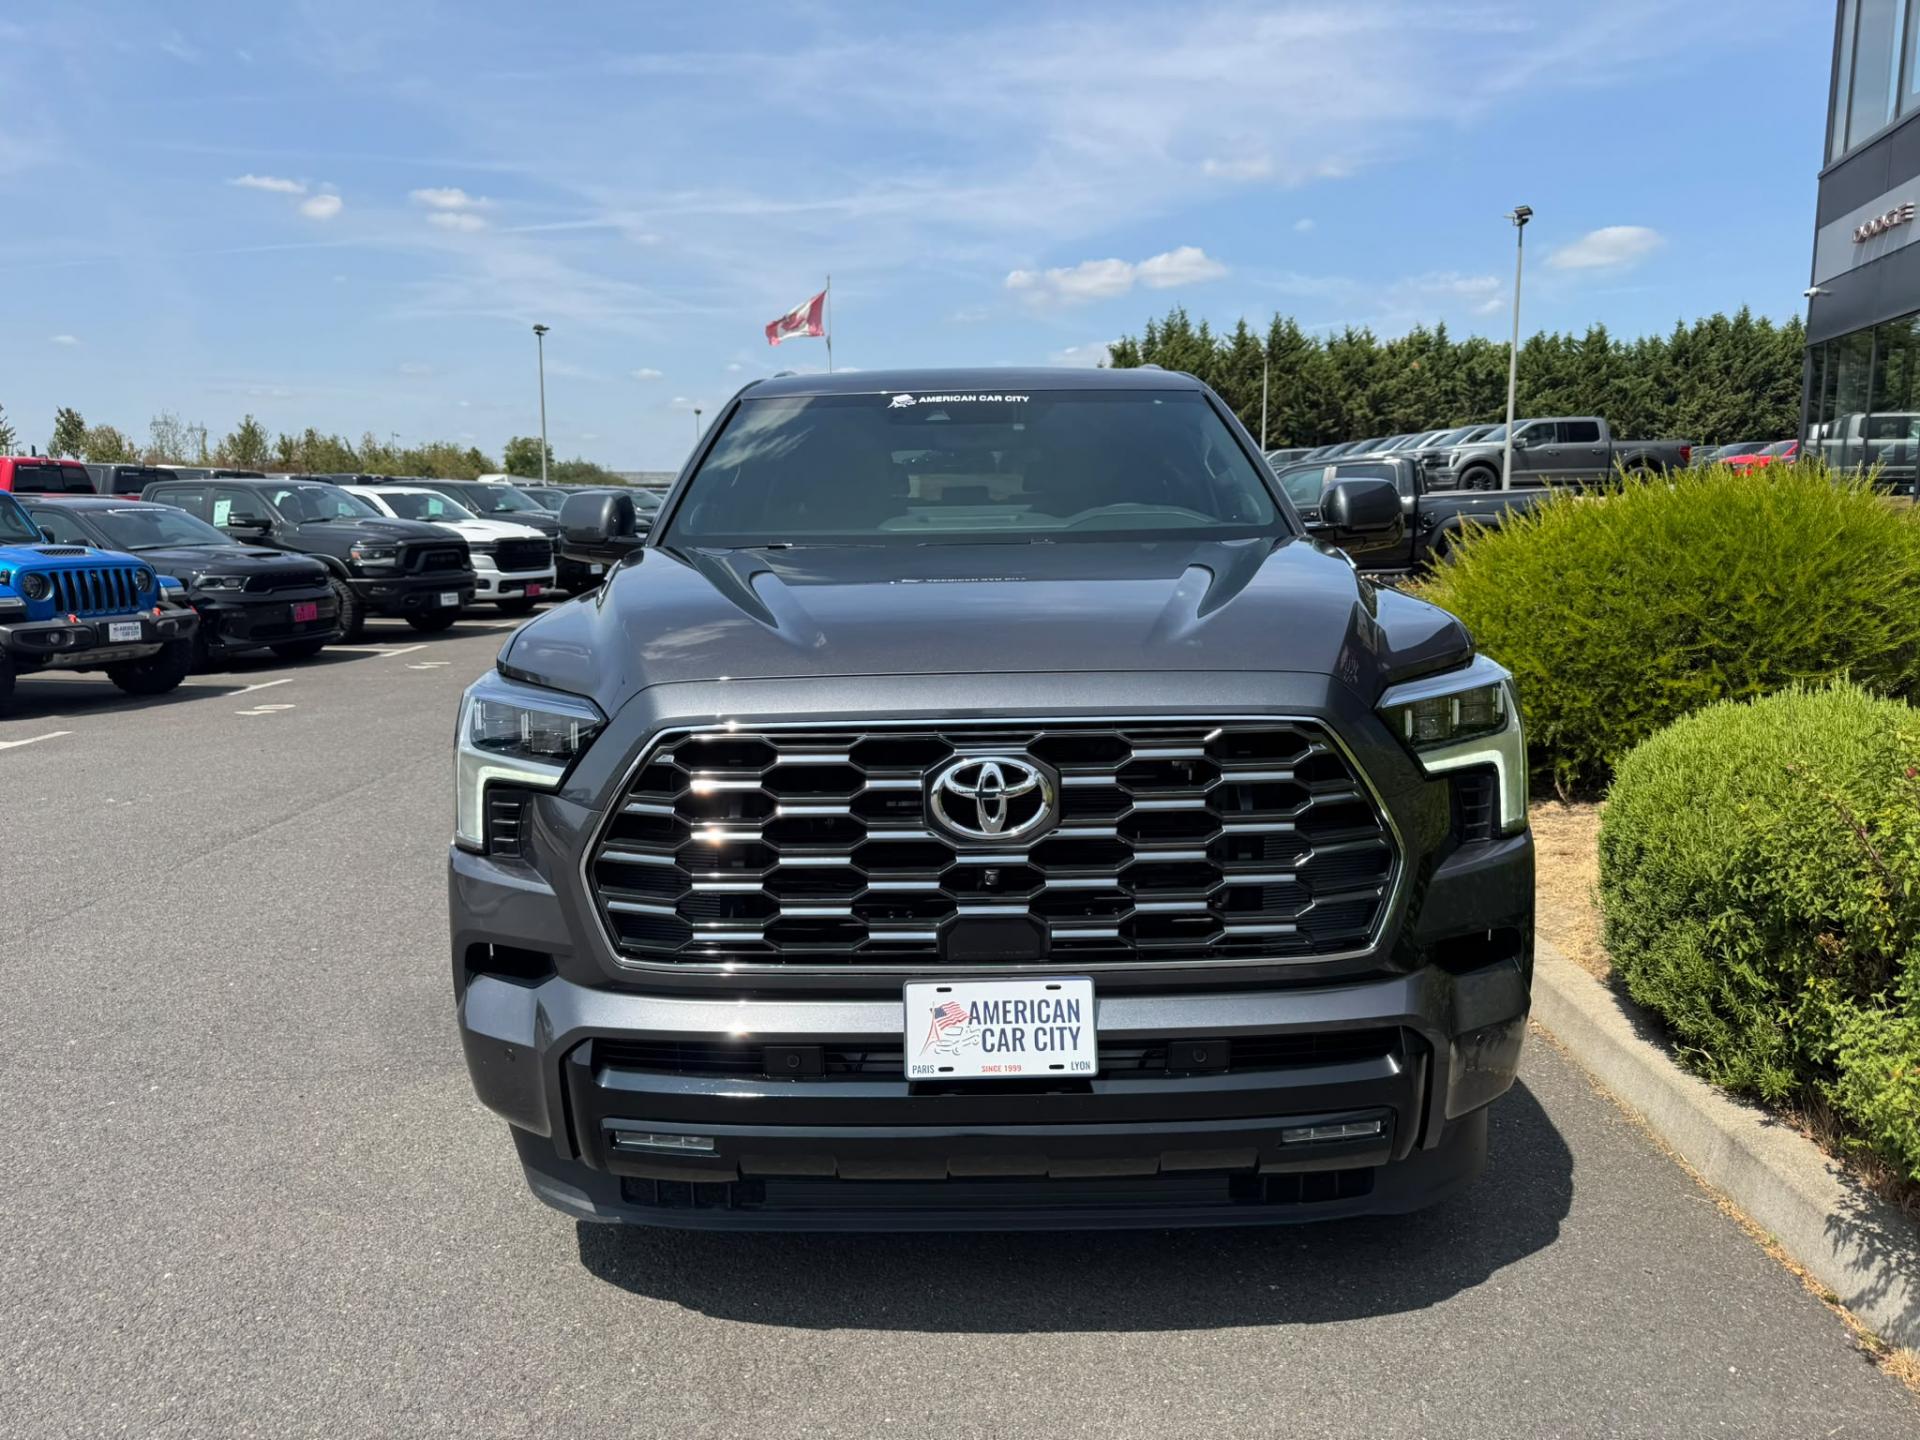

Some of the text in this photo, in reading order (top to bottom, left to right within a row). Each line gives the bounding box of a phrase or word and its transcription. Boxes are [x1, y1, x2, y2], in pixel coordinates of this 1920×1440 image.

[918, 395, 976, 403] AMERICAN
[968, 999, 1080, 1025] AMERICAN
[981, 1026, 1081, 1053] CAR CITY
[912, 1064, 935, 1074] PARIS
[981, 1064, 1022, 1073] SINCE 1999
[1071, 1061, 1091, 1071] LYON
